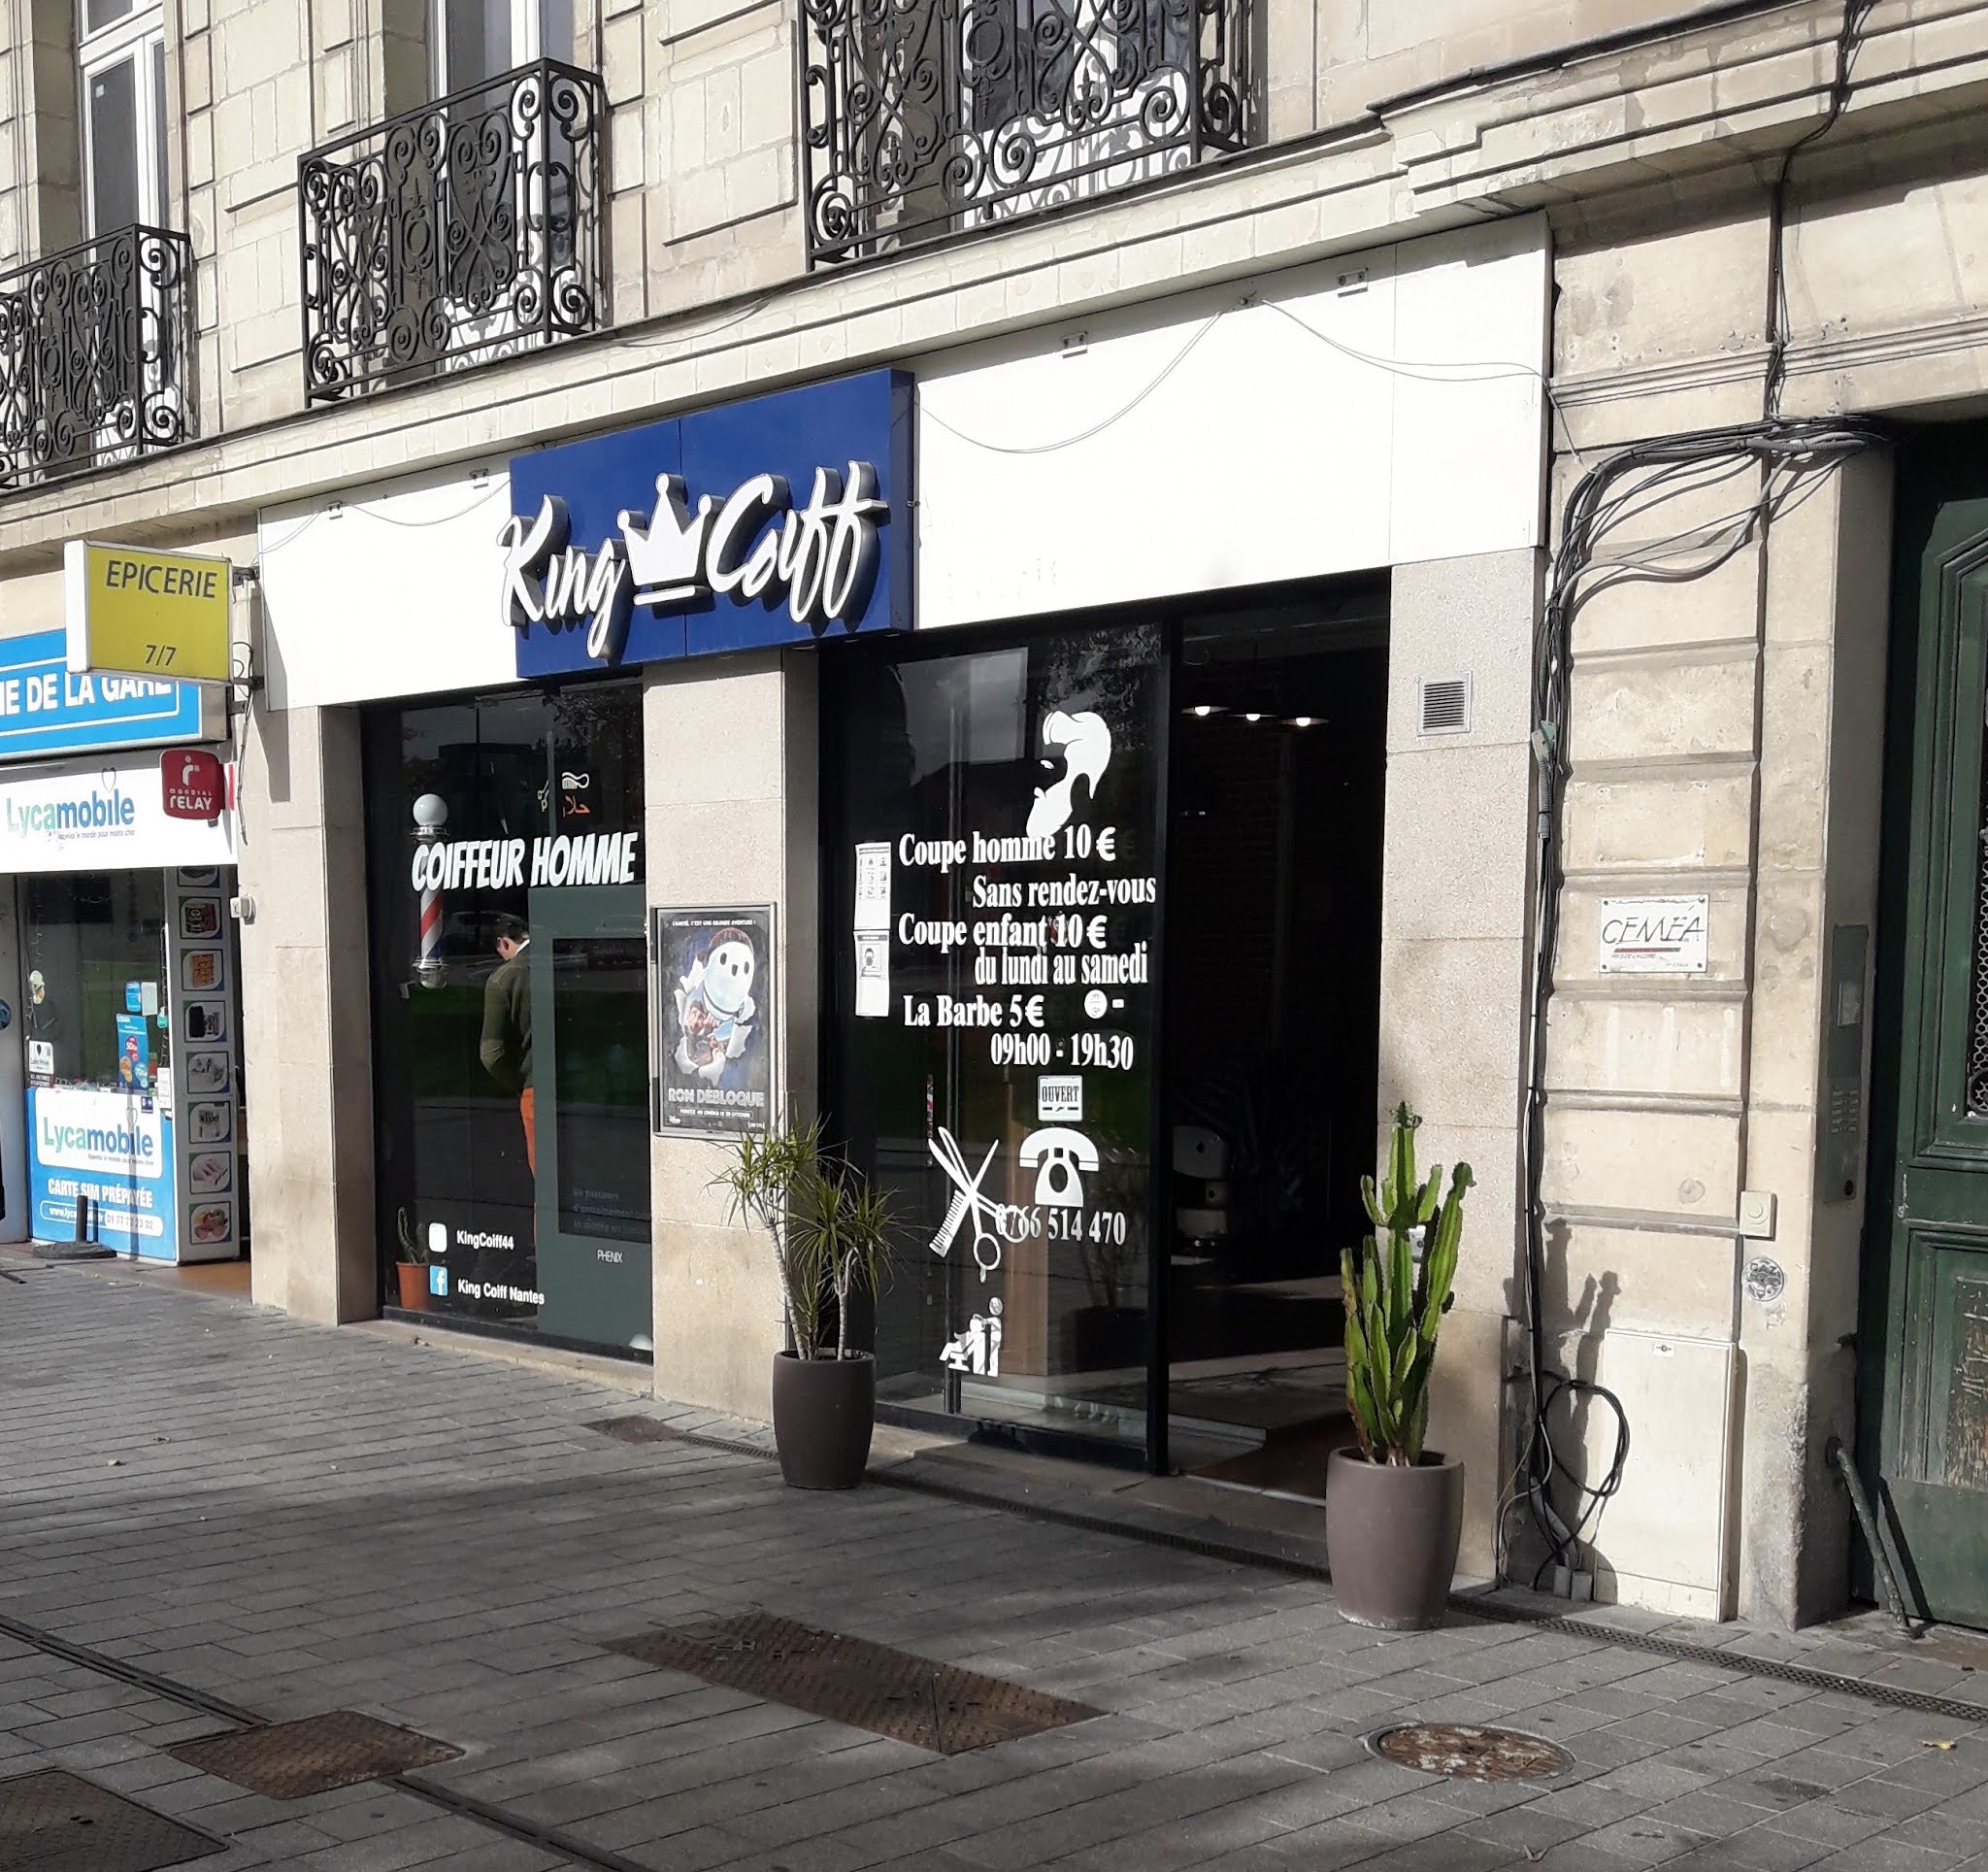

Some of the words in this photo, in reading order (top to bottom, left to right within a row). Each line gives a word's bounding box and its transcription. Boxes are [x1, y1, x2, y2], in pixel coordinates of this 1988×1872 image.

[497, 493, 625, 658] King
[707, 459, 889, 622] Coiff
[106, 559, 218, 599] EPICERIE
[146, 644, 177, 667] 7/7
[26, 672, 58, 712] DE
[65, 671, 95, 707] LA
[7, 788, 135, 839] Lycamobile
[412, 838, 525, 891] COIFFEUR
[529, 831, 639, 886] HOMME
[899, 831, 967, 874] Coupe
[972, 830, 1056, 863] homme
[1064, 824, 1091, 859] 10
[972, 874, 1023, 908] Sans
[1028, 873, 1157, 907] rendez-vous
[898, 912, 967, 953] Coupe
[973, 912, 1047, 948] enfant
[1055, 914, 1083, 948] 10
[975, 949, 998, 986] du
[1002, 946, 1048, 986] lundi
[1053, 951, 1077, 986] au
[1080, 940, 1147, 985] samedi
[904, 995, 930, 1027] La
[938, 995, 1003, 1027] Barbe
[990, 1033, 1050, 1066] 09h00
[1070, 1033, 1134, 1071] 19h30
[668, 1087, 695, 1103] RON
[697, 1086, 765, 1107] DÉBLOQUE
[1042, 1086, 1079, 1102] OUVERT
[44, 1117, 154, 1157] Lycamobile
[48, 1178, 79, 1196] CARTE
[80, 1182, 99, 1201] SIM
[456, 1229, 514, 1251] KingCoiff44
[1047, 1208, 1082, 1242] 514
[1088, 1211, 1126, 1246] 470
[597, 1249, 623, 1263] PHENIX
[457, 1279, 481, 1299] King
[483, 1282, 508, 1299] Coiff
[510, 1287, 545, 1305] Nantes
